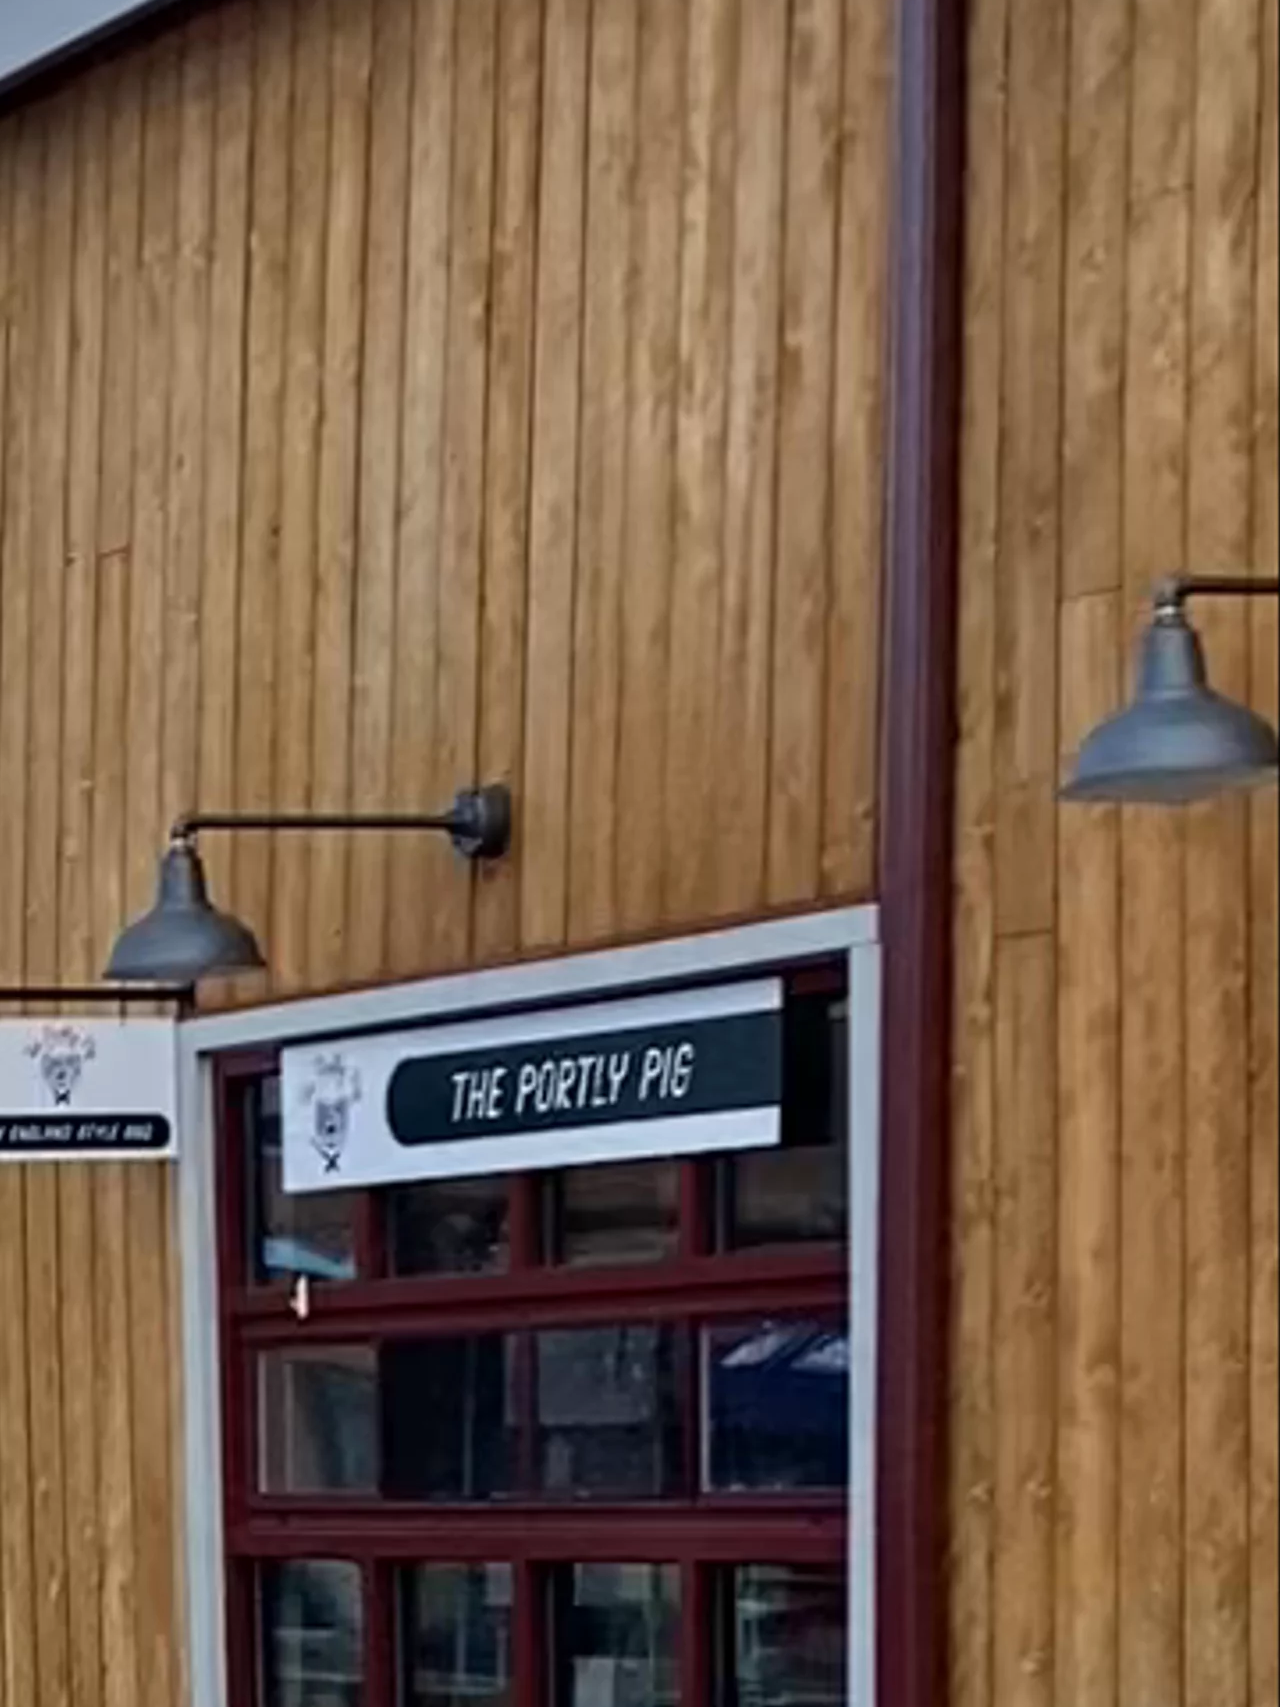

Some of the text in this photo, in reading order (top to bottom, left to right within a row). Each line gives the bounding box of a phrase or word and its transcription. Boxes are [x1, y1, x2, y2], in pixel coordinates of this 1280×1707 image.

[450, 1042, 694, 1122] THE PORTLY PIG
